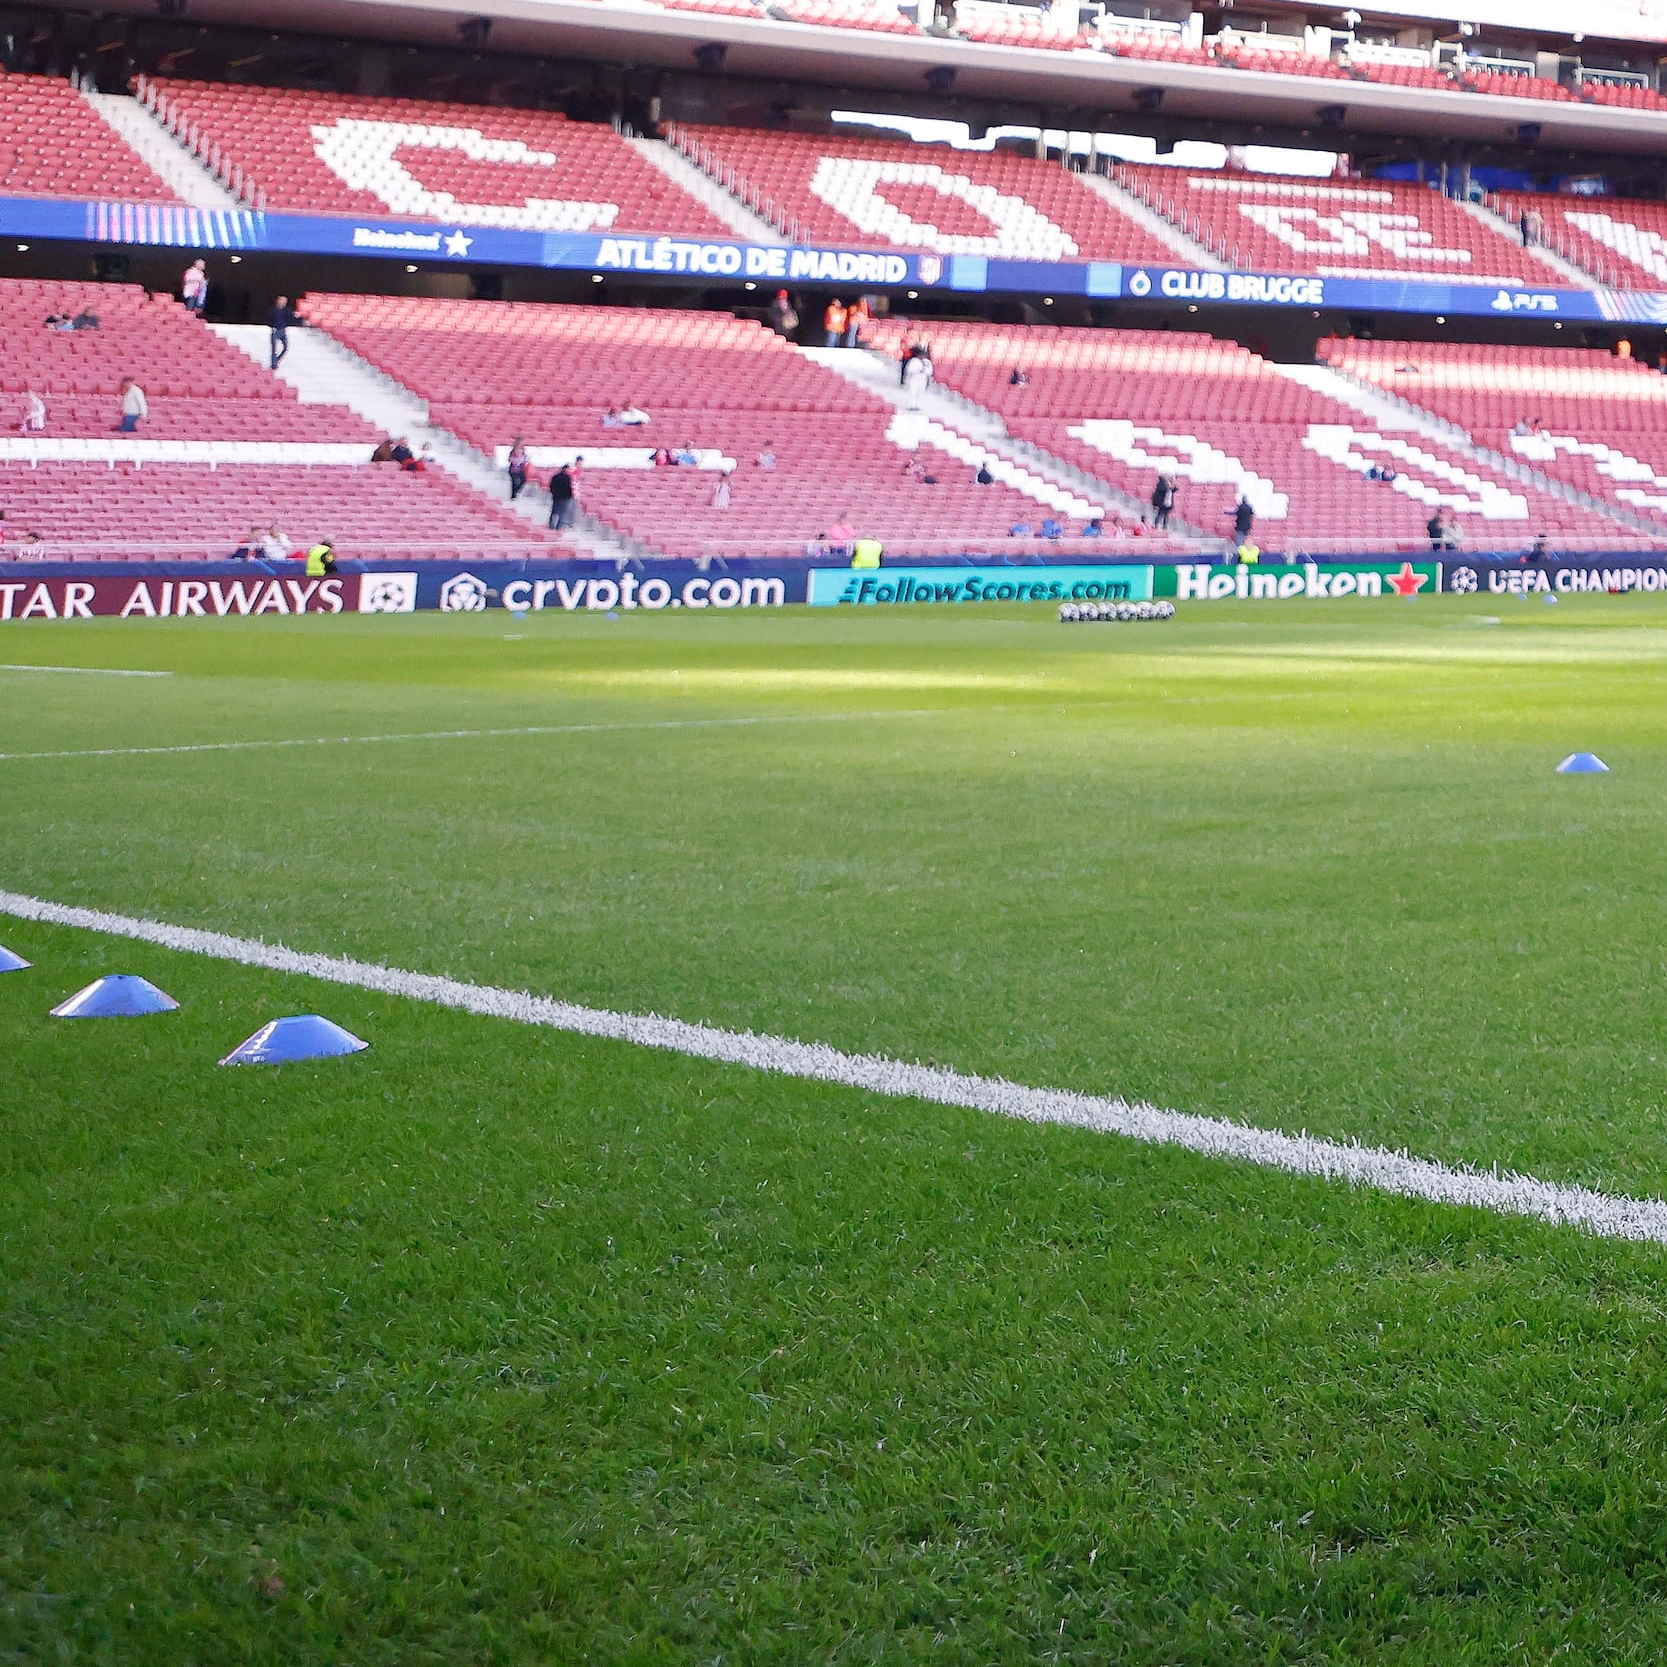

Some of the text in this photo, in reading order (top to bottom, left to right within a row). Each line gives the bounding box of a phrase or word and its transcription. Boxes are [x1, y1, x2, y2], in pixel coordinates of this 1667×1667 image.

[595, 236, 908, 283] ATLÉTICO DE MADRID
[1161, 270, 1325, 305] CLUB BRUGGE
[120, 579, 345, 619] AIRWAYS
[502, 572, 786, 611] crypto.com
[1175, 562, 1383, 600] Heineken
[1488, 568, 1551, 594] UEFA
